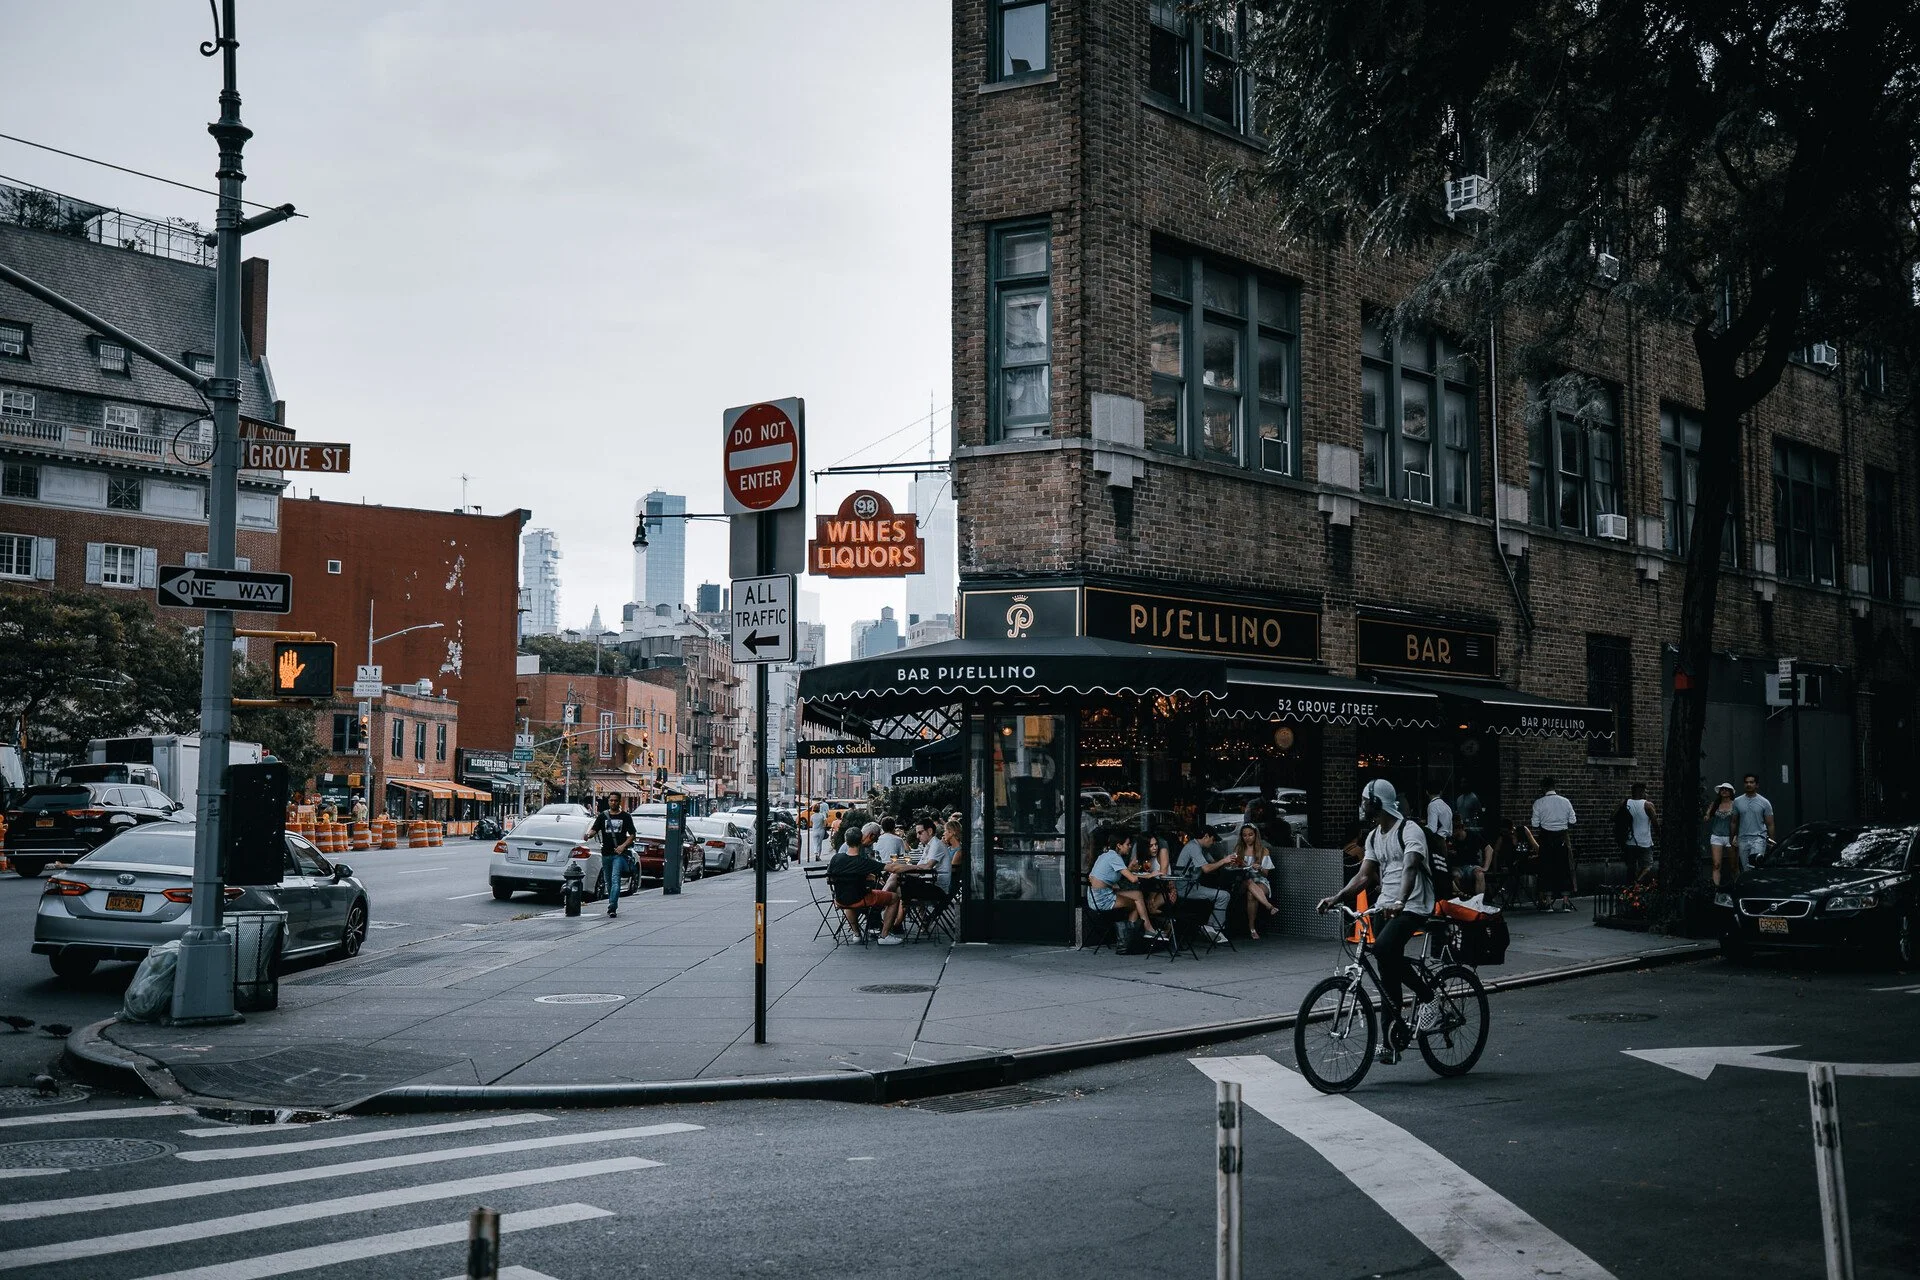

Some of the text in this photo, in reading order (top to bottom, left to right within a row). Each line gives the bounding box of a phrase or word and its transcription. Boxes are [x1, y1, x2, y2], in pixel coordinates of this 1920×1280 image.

[735, 422, 786, 445] DO NOT
[250, 444, 342, 470] GROVE ST
[740, 470, 781, 491] ENTER
[856, 500, 876, 514] 98
[826, 520, 906, 542] WINES
[818, 545, 916, 568] LIQUORS
[177, 580, 279, 600] ONE WAY
[745, 584, 777, 605] ALL
[736, 608, 786, 627] TRAFFIC
[1130, 604, 1281, 648] PISELLINO
[1407, 634, 1451, 664] BAR
[897, 666, 1036, 680] BAR PISELLINO
[1278, 699, 1292, 710] 52
[1298, 700, 1336, 713] GROVE
[1522, 716, 1585, 729] BAR PISELLINO
[810, 744, 876, 754] Boots & Saddle
[471, 759, 493, 767] BLEECKER
[895, 776, 937, 785] SUPREMA
